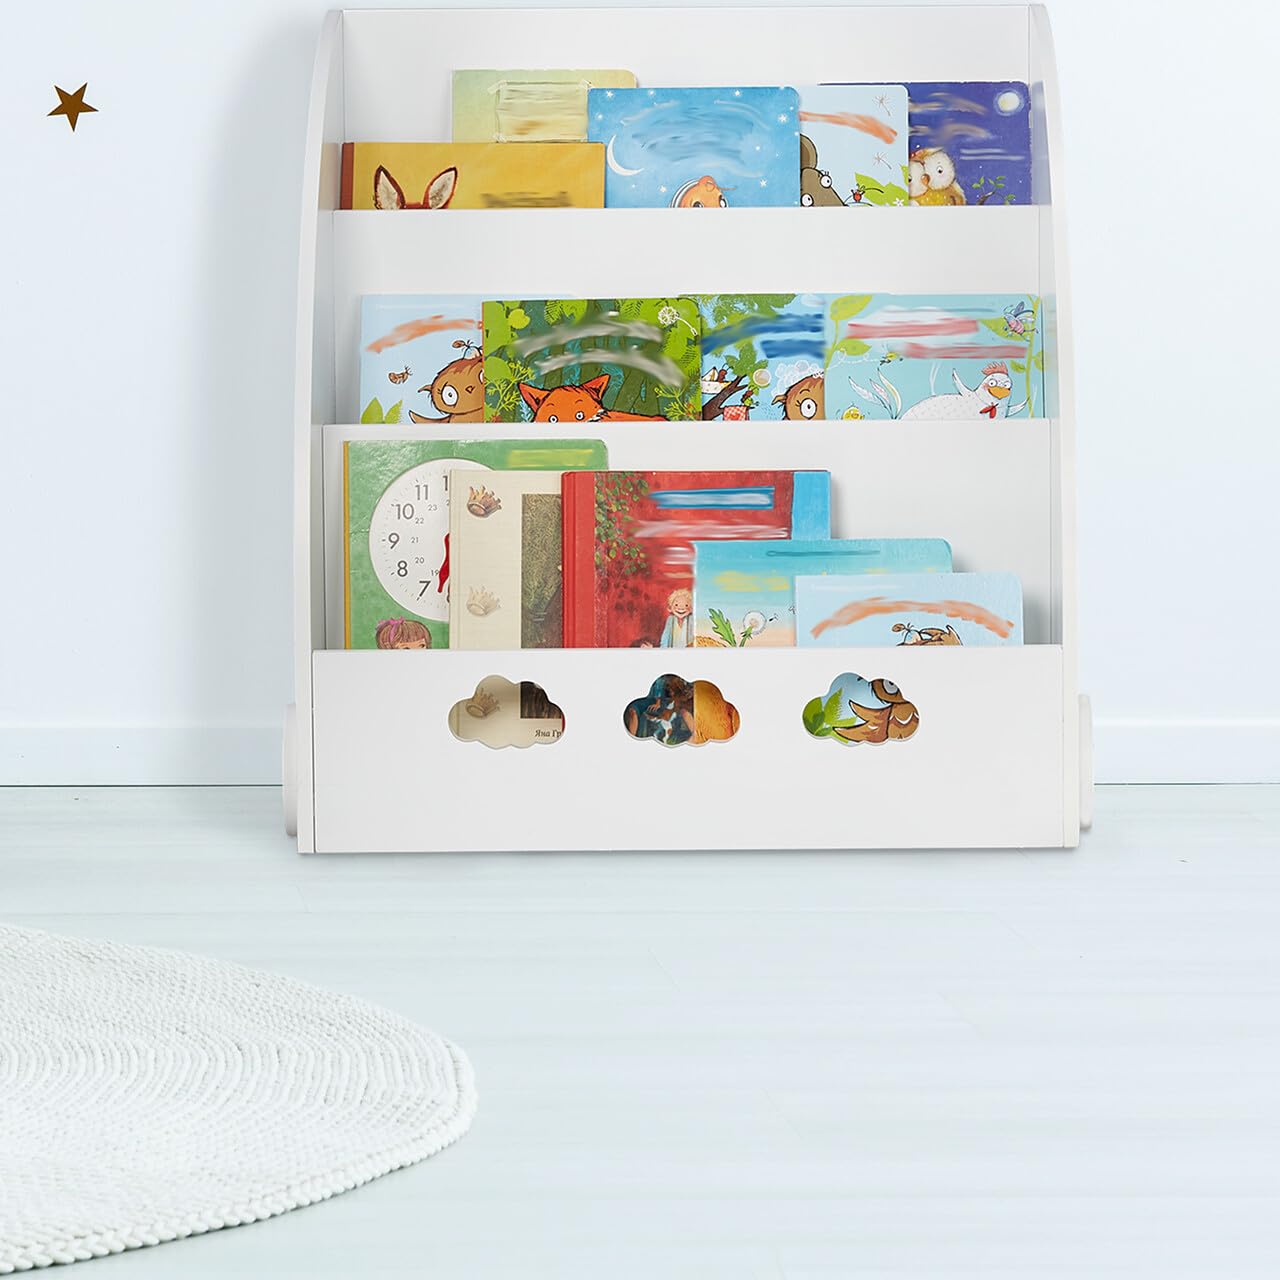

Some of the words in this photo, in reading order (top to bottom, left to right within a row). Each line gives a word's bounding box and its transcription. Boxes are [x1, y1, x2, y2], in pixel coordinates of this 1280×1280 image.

[415, 485, 429, 500] 11
[395, 503, 415, 520] 10
[388, 533, 400, 550] 9
[397, 560, 408, 577] 8
[419, 580, 431, 597] 7
[535, 729, 551, 737] Яна
